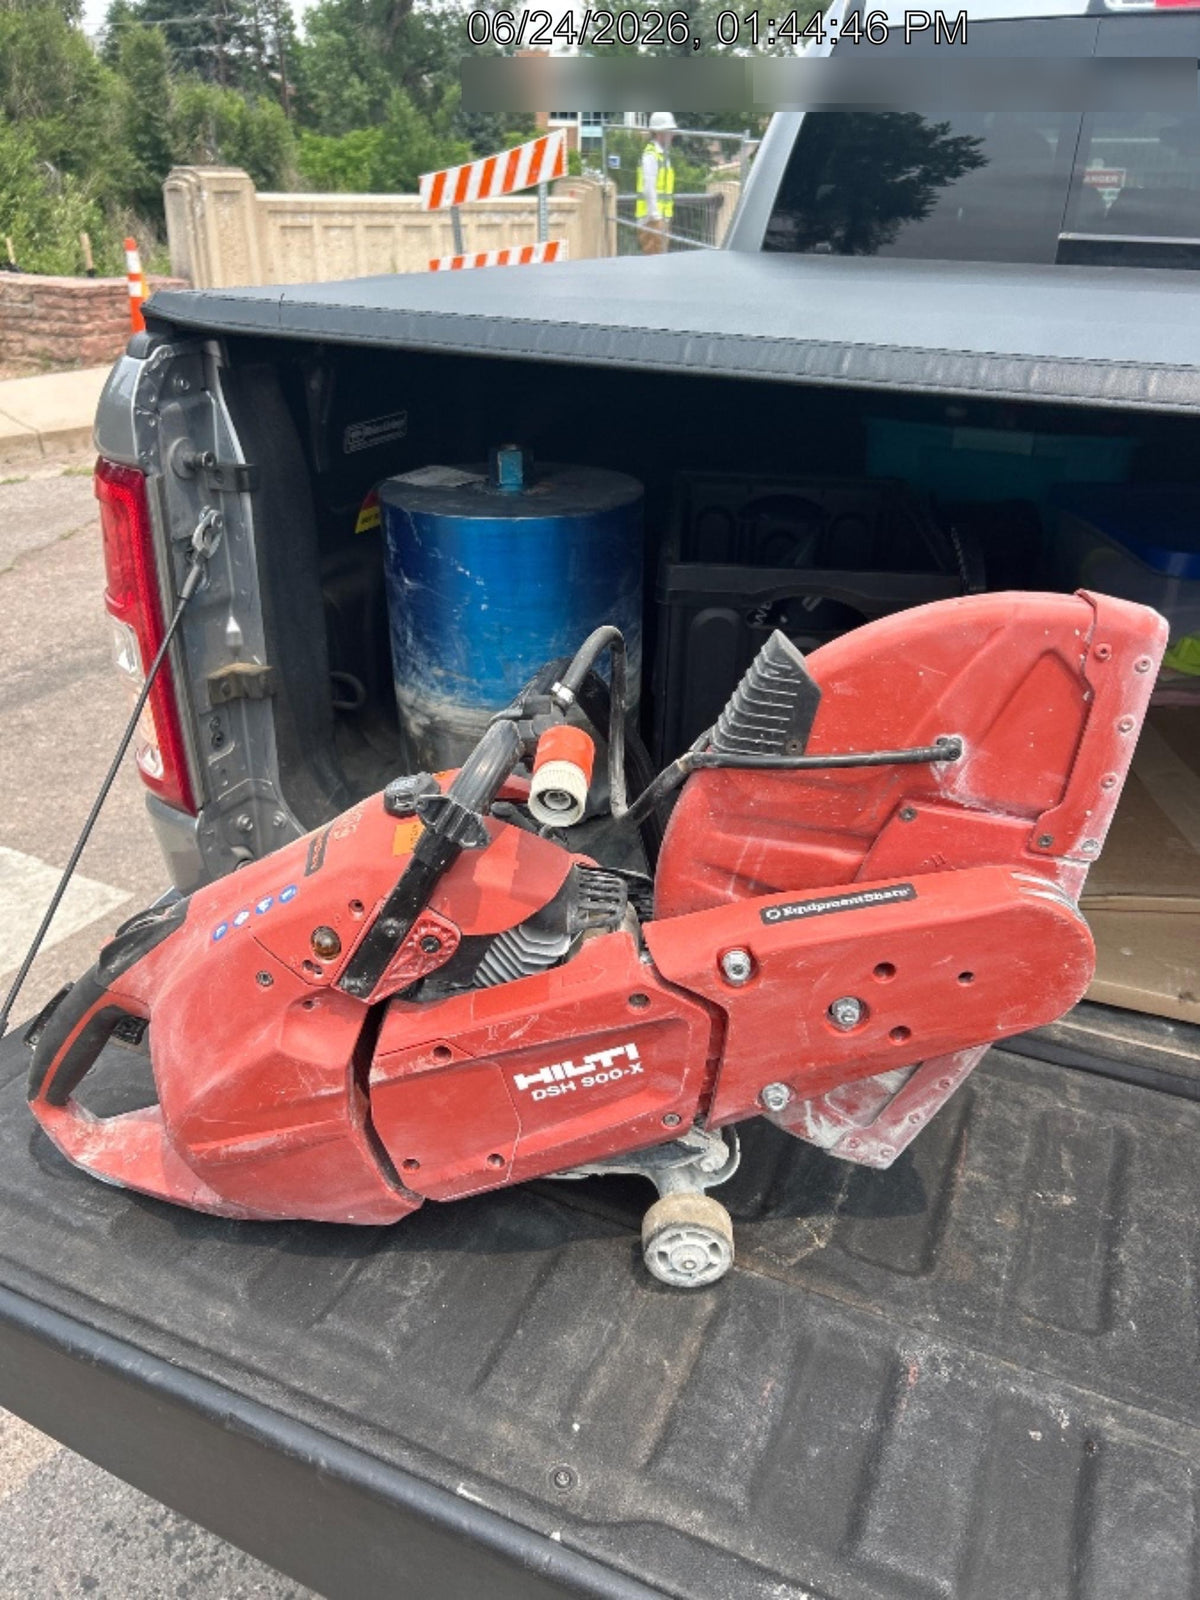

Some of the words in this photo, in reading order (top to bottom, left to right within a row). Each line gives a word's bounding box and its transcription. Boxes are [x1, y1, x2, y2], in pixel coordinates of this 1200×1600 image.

[782, 889, 909, 916] EquipmentShare
[513, 1043, 639, 1090] HILTI
[531, 1080, 577, 1101] DSH
[580, 1061, 644, 1087] 900-X
